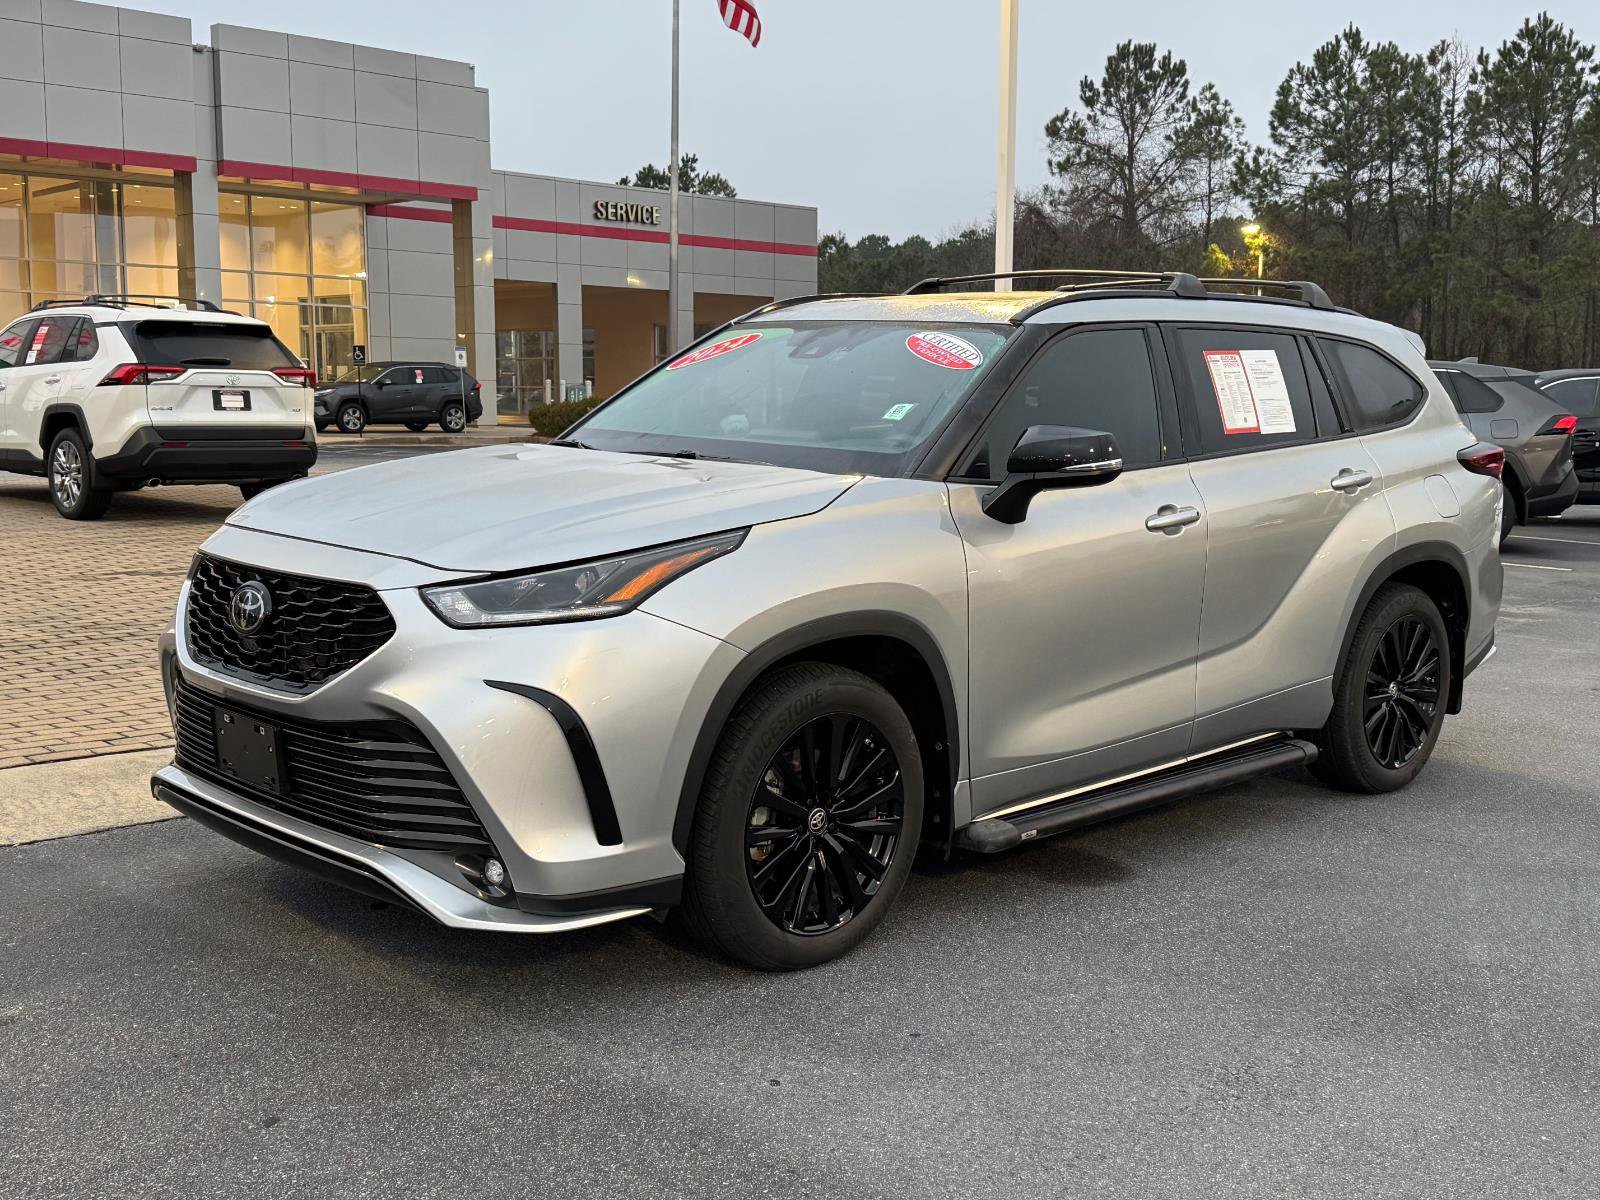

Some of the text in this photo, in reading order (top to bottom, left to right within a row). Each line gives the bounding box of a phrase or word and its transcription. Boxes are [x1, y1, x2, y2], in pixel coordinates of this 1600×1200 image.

[593, 199, 661, 225] SERVICE
[680, 335, 750, 367] 2024
[915, 340, 963, 364] PRE-OWNED
[916, 346, 948, 365] VEHICLE
[923, 332, 979, 361] CERTIFIED
[734, 687, 825, 800] BRIDGESTONE
